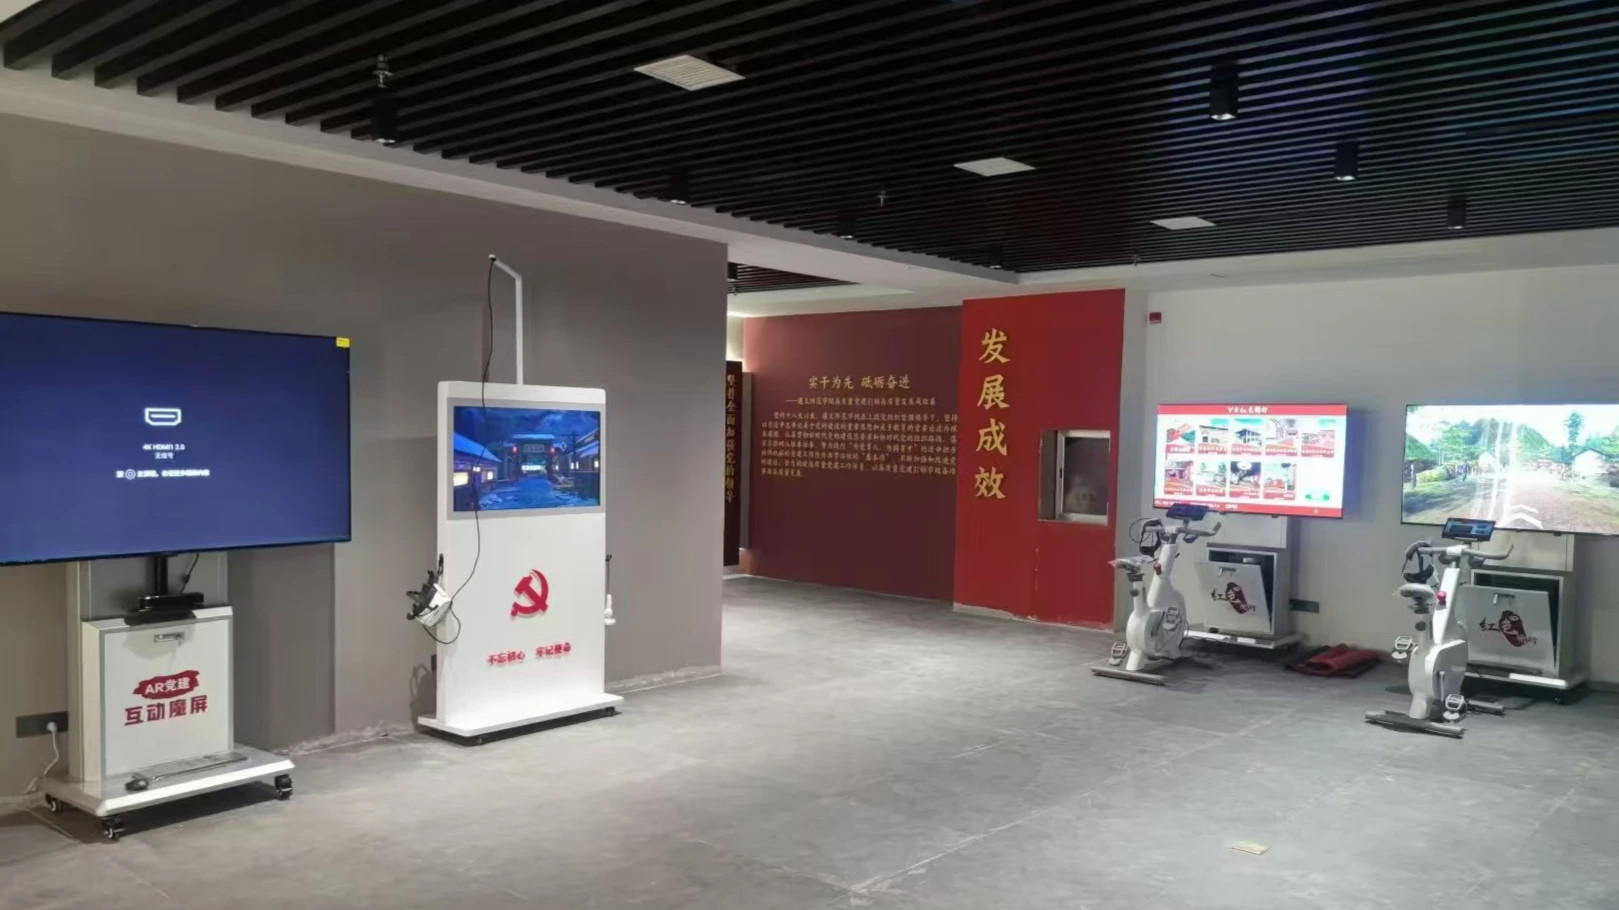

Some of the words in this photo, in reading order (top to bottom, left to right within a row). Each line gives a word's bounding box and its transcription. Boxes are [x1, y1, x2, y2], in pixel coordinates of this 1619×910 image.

[808, 376, 854, 390] 实干为先
[860, 374, 911, 390] 砥砺奋进
[974, 328, 1010, 499] 发展成效
[487, 650, 526, 665] 不忘初心
[536, 642, 571, 657] 牢记使命
[145, 676, 191, 695] AR党建
[124, 694, 208, 726] 互动魔屏
